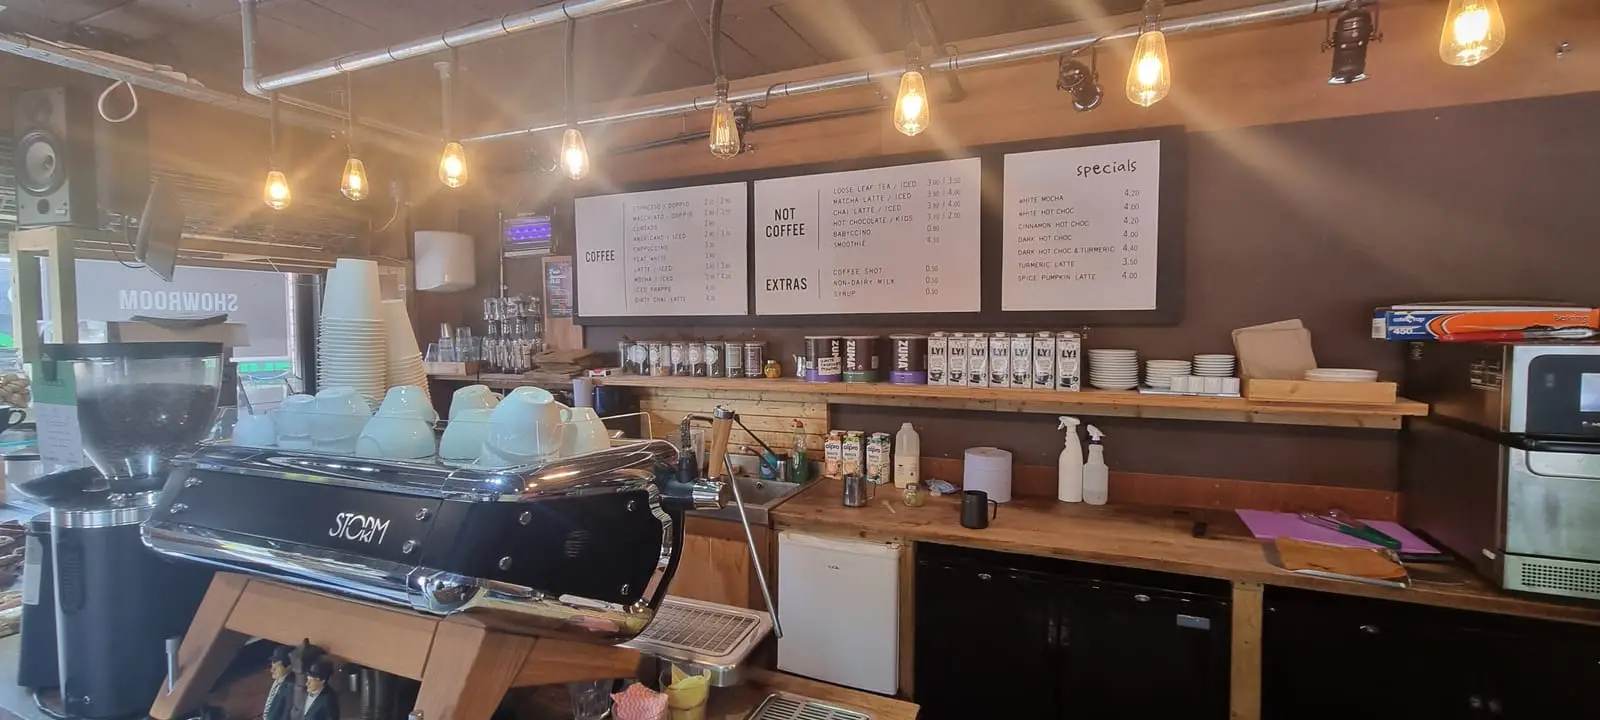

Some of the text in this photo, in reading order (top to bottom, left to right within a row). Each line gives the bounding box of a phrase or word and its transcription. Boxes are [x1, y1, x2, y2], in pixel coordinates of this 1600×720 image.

[1076, 159, 1137, 178] specials
[833, 187, 853, 195] LOOSE
[857, 185, 873, 193] LEAF
[878, 183, 891, 191] TEA
[1124, 189, 1140, 197] 4.20
[833, 197, 859, 205] MATCHA
[863, 195, 884, 203] LATTE
[895, 192, 912, 200] ICED
[833, 208, 849, 216] CHAI
[854, 207, 875, 215] LATTE
[885, 204, 901, 212] ICED
[1124, 203, 1139, 211] 4.00
[774, 207, 796, 221] NOT
[833, 219, 845, 227] HOT
[849, 217, 887, 226] CHOCOLATE
[896, 215, 913, 223] KIDS
[1018, 222, 1051, 230] CINNAMON
[1123, 217, 1139, 225] 4.20
[672, 233, 687, 241] ICED
[765, 224, 805, 238] COFFEE
[833, 229, 871, 238] BABYCCINO
[833, 240, 865, 249] SMOOTHIE
[1081, 245, 1115, 253] TURMERIC
[1123, 244, 1138, 252] 4.40
[585, 250, 615, 263] COFFEE
[1018, 261, 1050, 269] TURMERIC
[1122, 257, 1138, 265] 3.50
[833, 268, 860, 276] COFFEE
[864, 267, 883, 275] SHOT
[1018, 274, 1037, 282] SPICE
[1122, 271, 1138, 279] 4.00
[766, 277, 807, 291] EXTRAS
[833, 279, 873, 287] NON-DAIRY
[877, 278, 896, 286] MILK
[833, 289, 857, 298] SYRUP
[831, 340, 840, 358] ZUM
[846, 340, 856, 369] ZUMA
[897, 340, 909, 369] ZUMA
[1062, 349, 1077, 358] LY!
[328, 512, 391, 545] STORM
